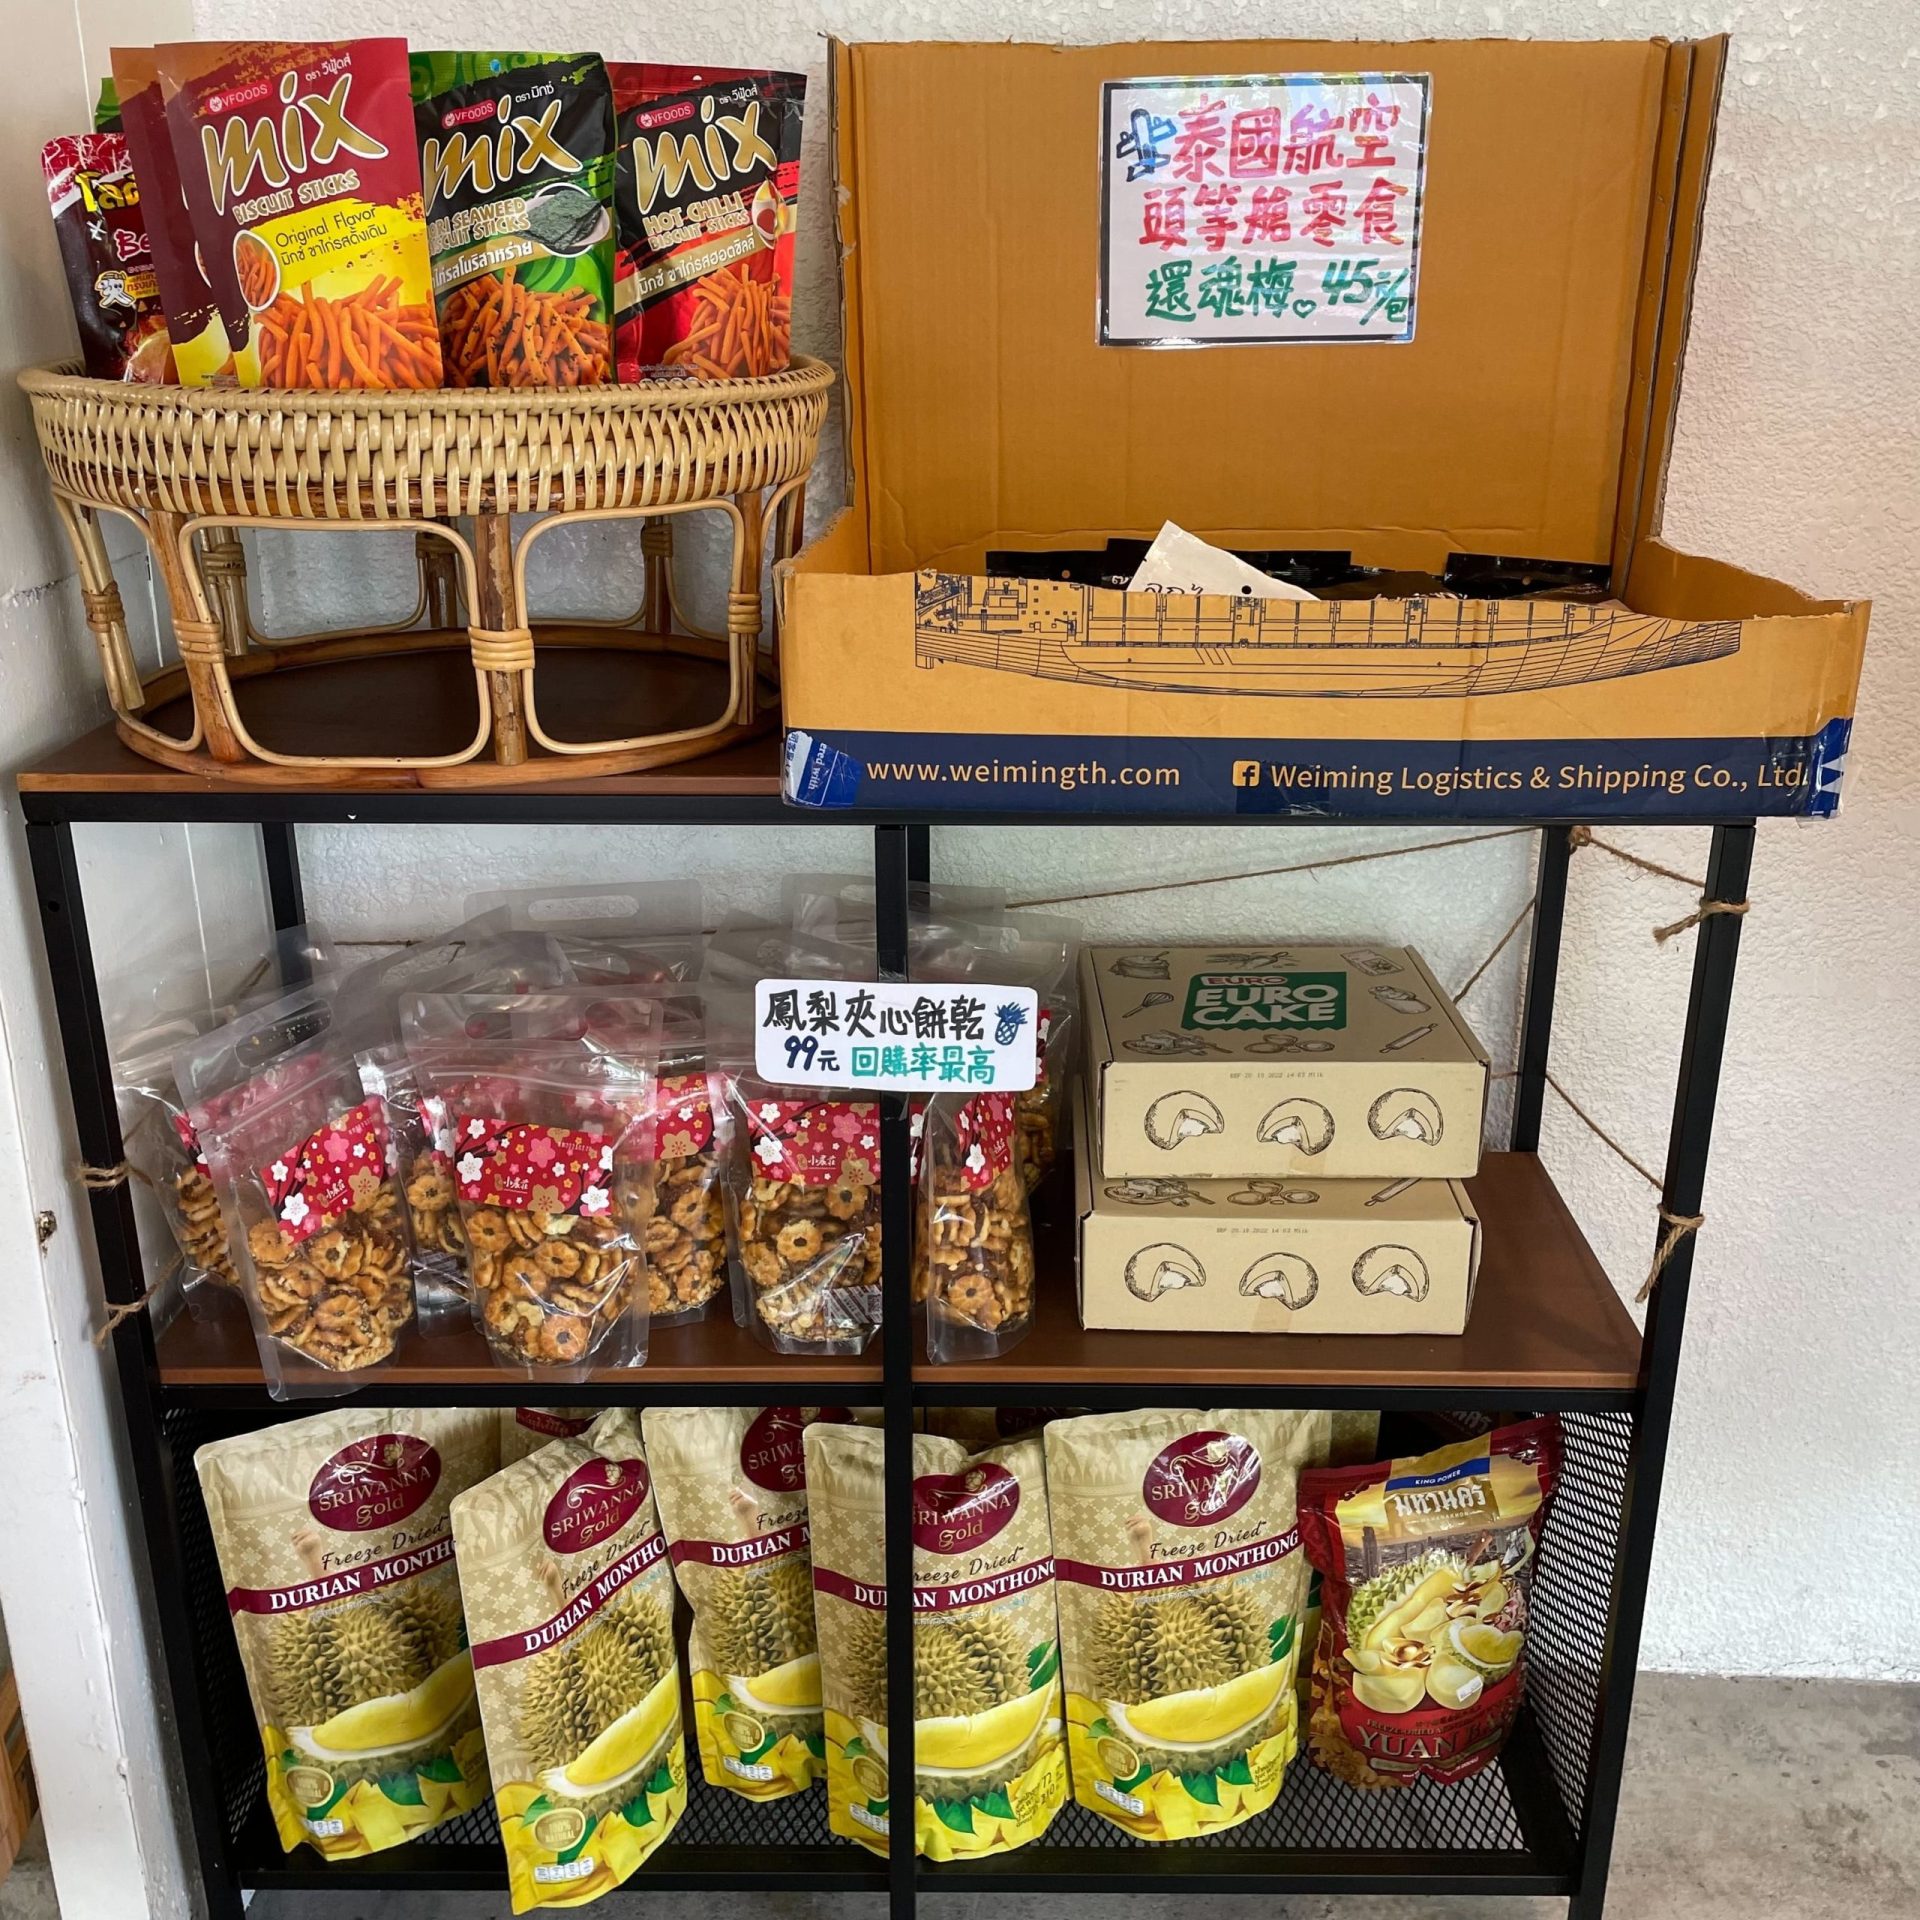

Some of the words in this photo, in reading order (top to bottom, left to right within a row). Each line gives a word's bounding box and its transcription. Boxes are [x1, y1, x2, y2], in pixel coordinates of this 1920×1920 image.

[221, 84, 268, 107] VFOODS
[454, 103, 494, 121] VFOODS
[652, 106, 691, 124] VFOODS
[1173, 93, 1401, 182] 泰國航空
[232, 188, 294, 225] BISCUIT
[297, 169, 361, 204] STICKS
[642, 207, 684, 236] HOT
[687, 191, 745, 222] CHILLI
[1139, 176, 1409, 252] 頭等艙零食
[276, 217, 329, 247] Original
[333, 208, 376, 230] Flavor
[428, 216, 451, 239] ORI
[452, 197, 527, 229] SEAWEED
[429, 226, 471, 256] ISCUIT
[473, 213, 531, 240] STICKS
[648, 224, 702, 252] BISCUIT
[707, 209, 750, 233] STICKS
[1145, 255, 1298, 322] 還魂梅
[806, 767, 821, 791] with
[867, 759, 1181, 790] www.weimingth.com
[1271, 764, 1394, 796] Weiming
[1401, 766, 1522, 796] Logistics
[1529, 766, 1551, 789] &
[1558, 764, 1687, 794] Shipping
[1694, 764, 1748, 792] Co.,
[1195, 984, 1339, 1007] EURO
[1203, 976, 1288, 986] EURO
[763, 988, 986, 1041] 鳳梨夾心餅乾
[1192, 1002, 1336, 1025] CAKE
[784, 1035, 840, 1072] 99元
[851, 1042, 995, 1085] 回購率最高
[319, 1465, 431, 1512] SRIWANNA
[1415, 1477, 1436, 1485] KING
[1437, 1469, 1461, 1483] POWER
[355, 1493, 405, 1527] Gold
[551, 1480, 645, 1538] SRIWANNA
[579, 1510, 620, 1545] Gold
[321, 1544, 383, 1570] Freeze
[391, 1515, 449, 1550] Dried
[711, 1532, 791, 1563] DURIAN
[939, 1519, 983, 1551] Gold
[1150, 1540, 1206, 1560] Freeze
[1214, 1520, 1267, 1549] Dried
[270, 1570, 361, 1611] DURIAN
[371, 1539, 456, 1585] MONTH
[561, 1561, 599, 1599] Freeze
[606, 1520, 650, 1560] Dried
[912, 1570, 960, 1585] reeze
[969, 1546, 1024, 1575] Dried
[1101, 1565, 1184, 1588] DURIAN
[1193, 1529, 1298, 1579] MONTHONG
[523, 1595, 593, 1652] DURIAN
[596, 1537, 666, 1599] MONTHO
[1356, 1725, 1456, 1759] YUAN
